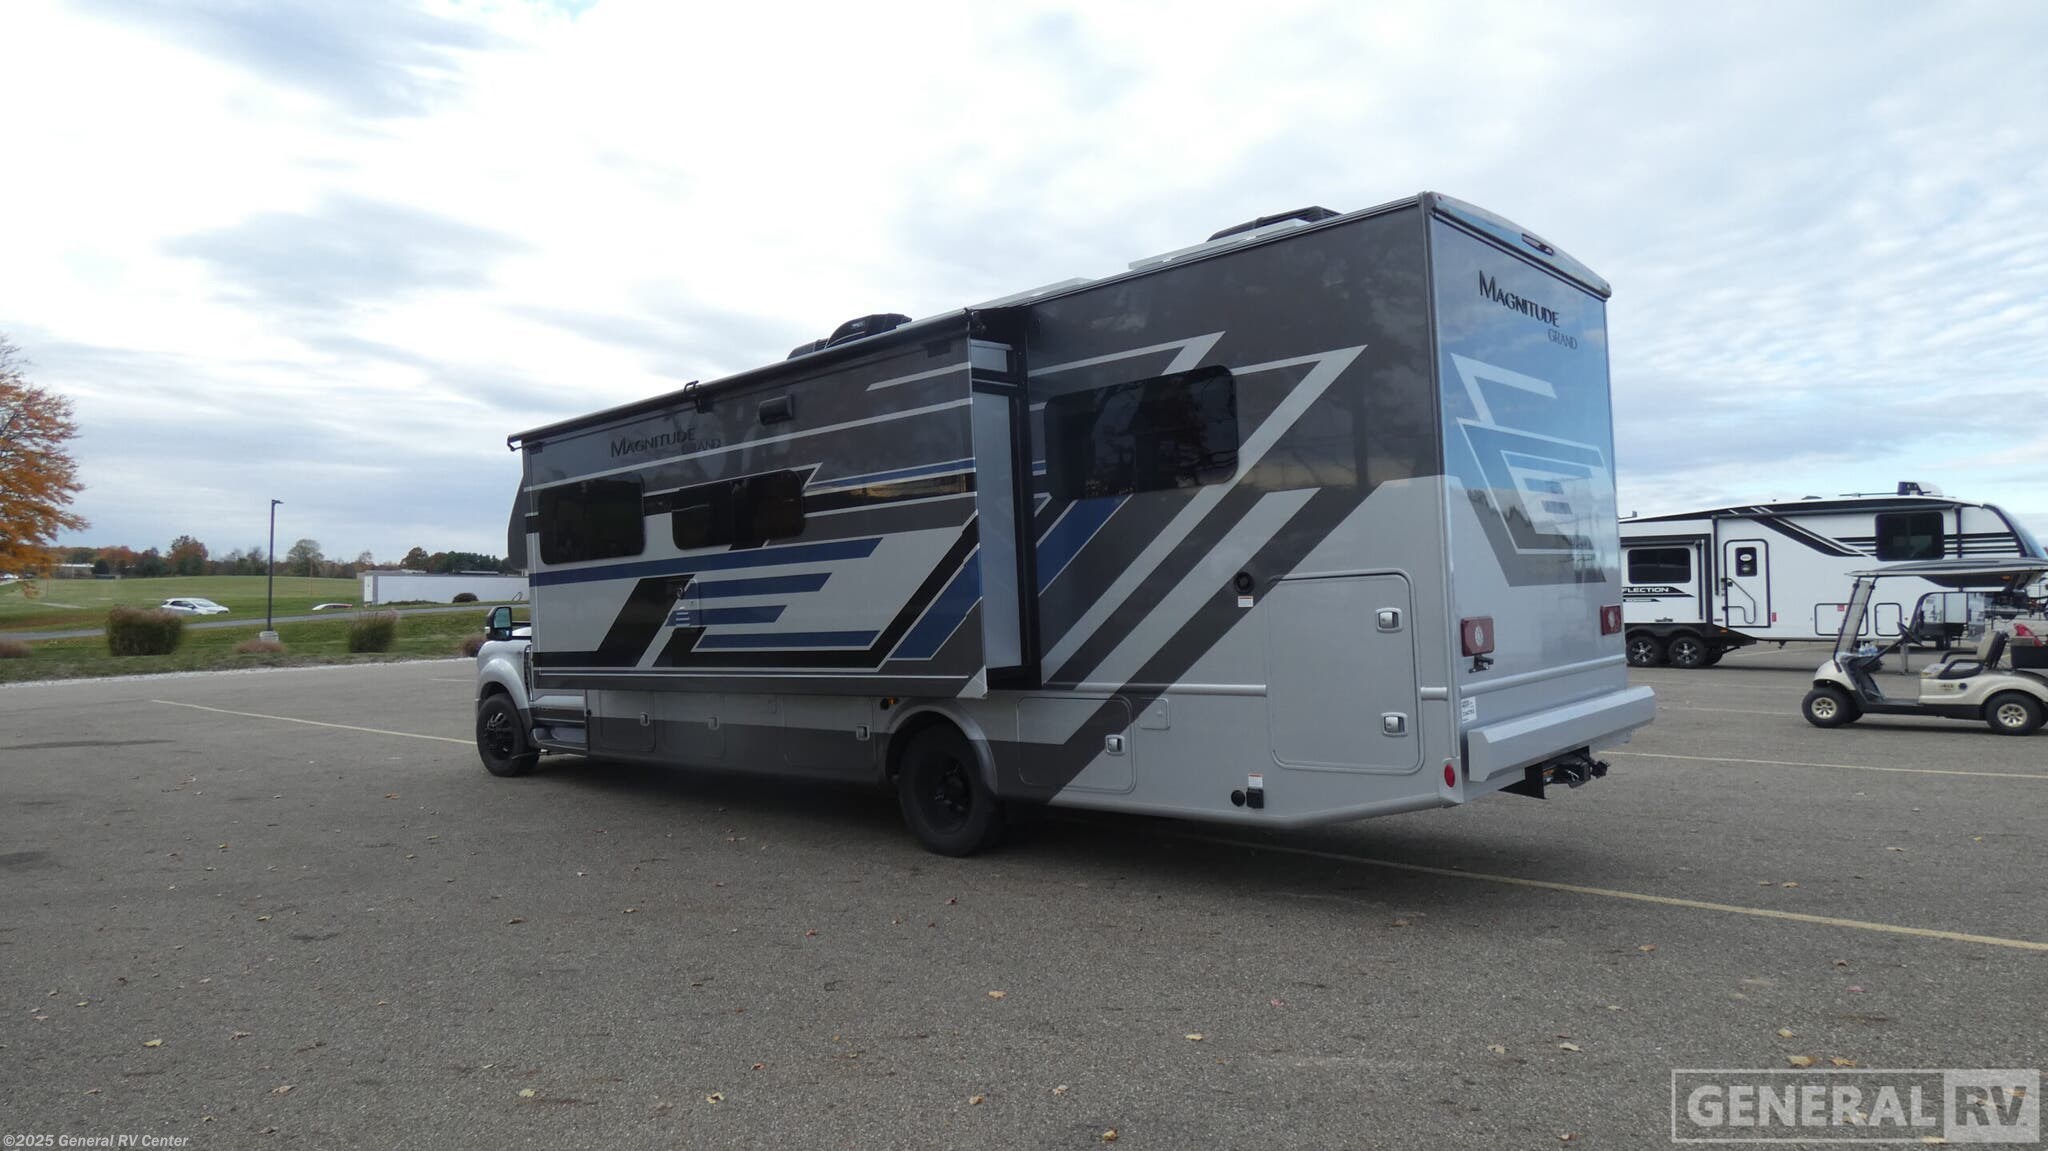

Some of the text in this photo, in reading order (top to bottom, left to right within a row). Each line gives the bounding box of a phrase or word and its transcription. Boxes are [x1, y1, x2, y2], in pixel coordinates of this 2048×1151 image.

[1479, 270, 1560, 328] MAGNITUDE
[1548, 329, 1578, 350] GRAND
[611, 428, 696, 458] MAGNITUDE
